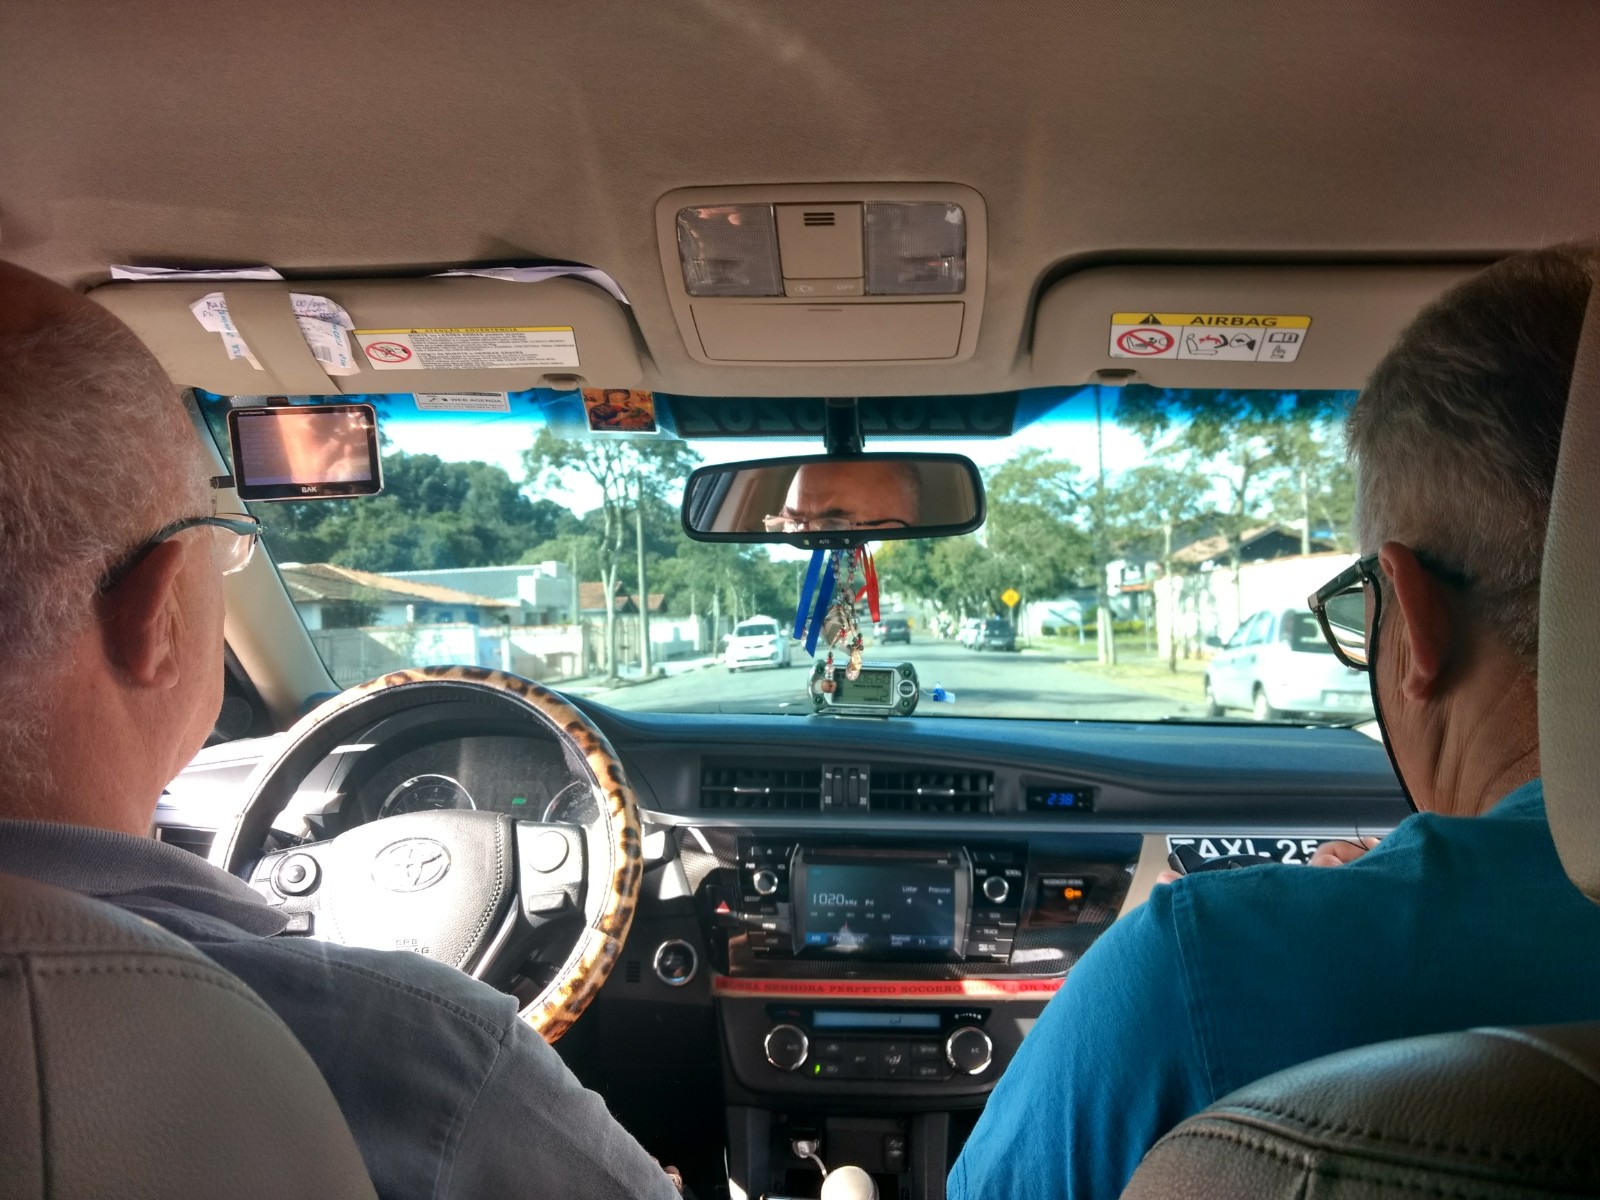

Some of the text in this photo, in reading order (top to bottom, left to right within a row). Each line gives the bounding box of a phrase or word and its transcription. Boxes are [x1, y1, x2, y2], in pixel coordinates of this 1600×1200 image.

[1190, 316, 1277, 327] AIRBAG
[1047, 792, 1074, 806] 2:38
[812, 893, 845, 905] 1020
[811, 934, 821, 942] AM
[764, 984, 825, 993] SENHORA
[829, 985, 896, 993] PERPETUO
[901, 985, 962, 993] SOCORRO
